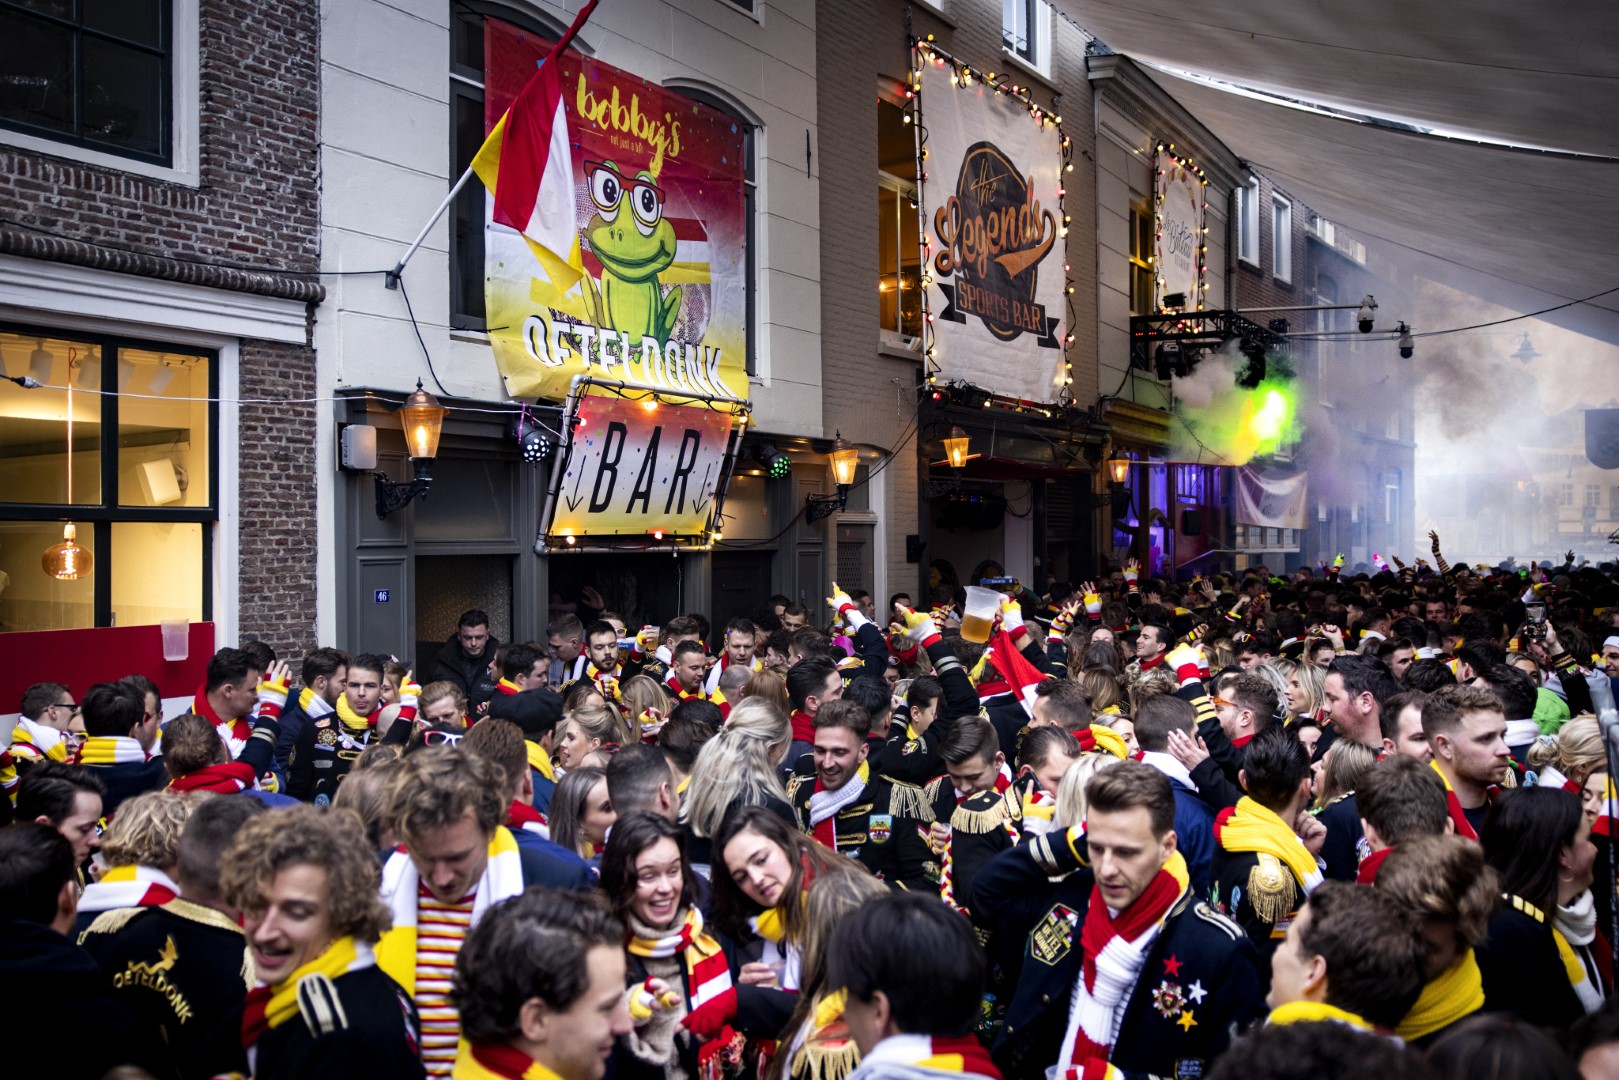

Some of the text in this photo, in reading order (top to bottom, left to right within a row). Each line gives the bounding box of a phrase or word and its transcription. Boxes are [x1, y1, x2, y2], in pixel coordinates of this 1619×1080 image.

[577, 72, 681, 178] bobby's
[970, 158, 1008, 209] the
[934, 175, 1056, 279] Legends
[958, 280, 1042, 332] SPORTS BAR
[588, 421, 702, 515] BAR
[377, 591, 387, 602] 46
[112, 969, 194, 1025] OETELDONK
